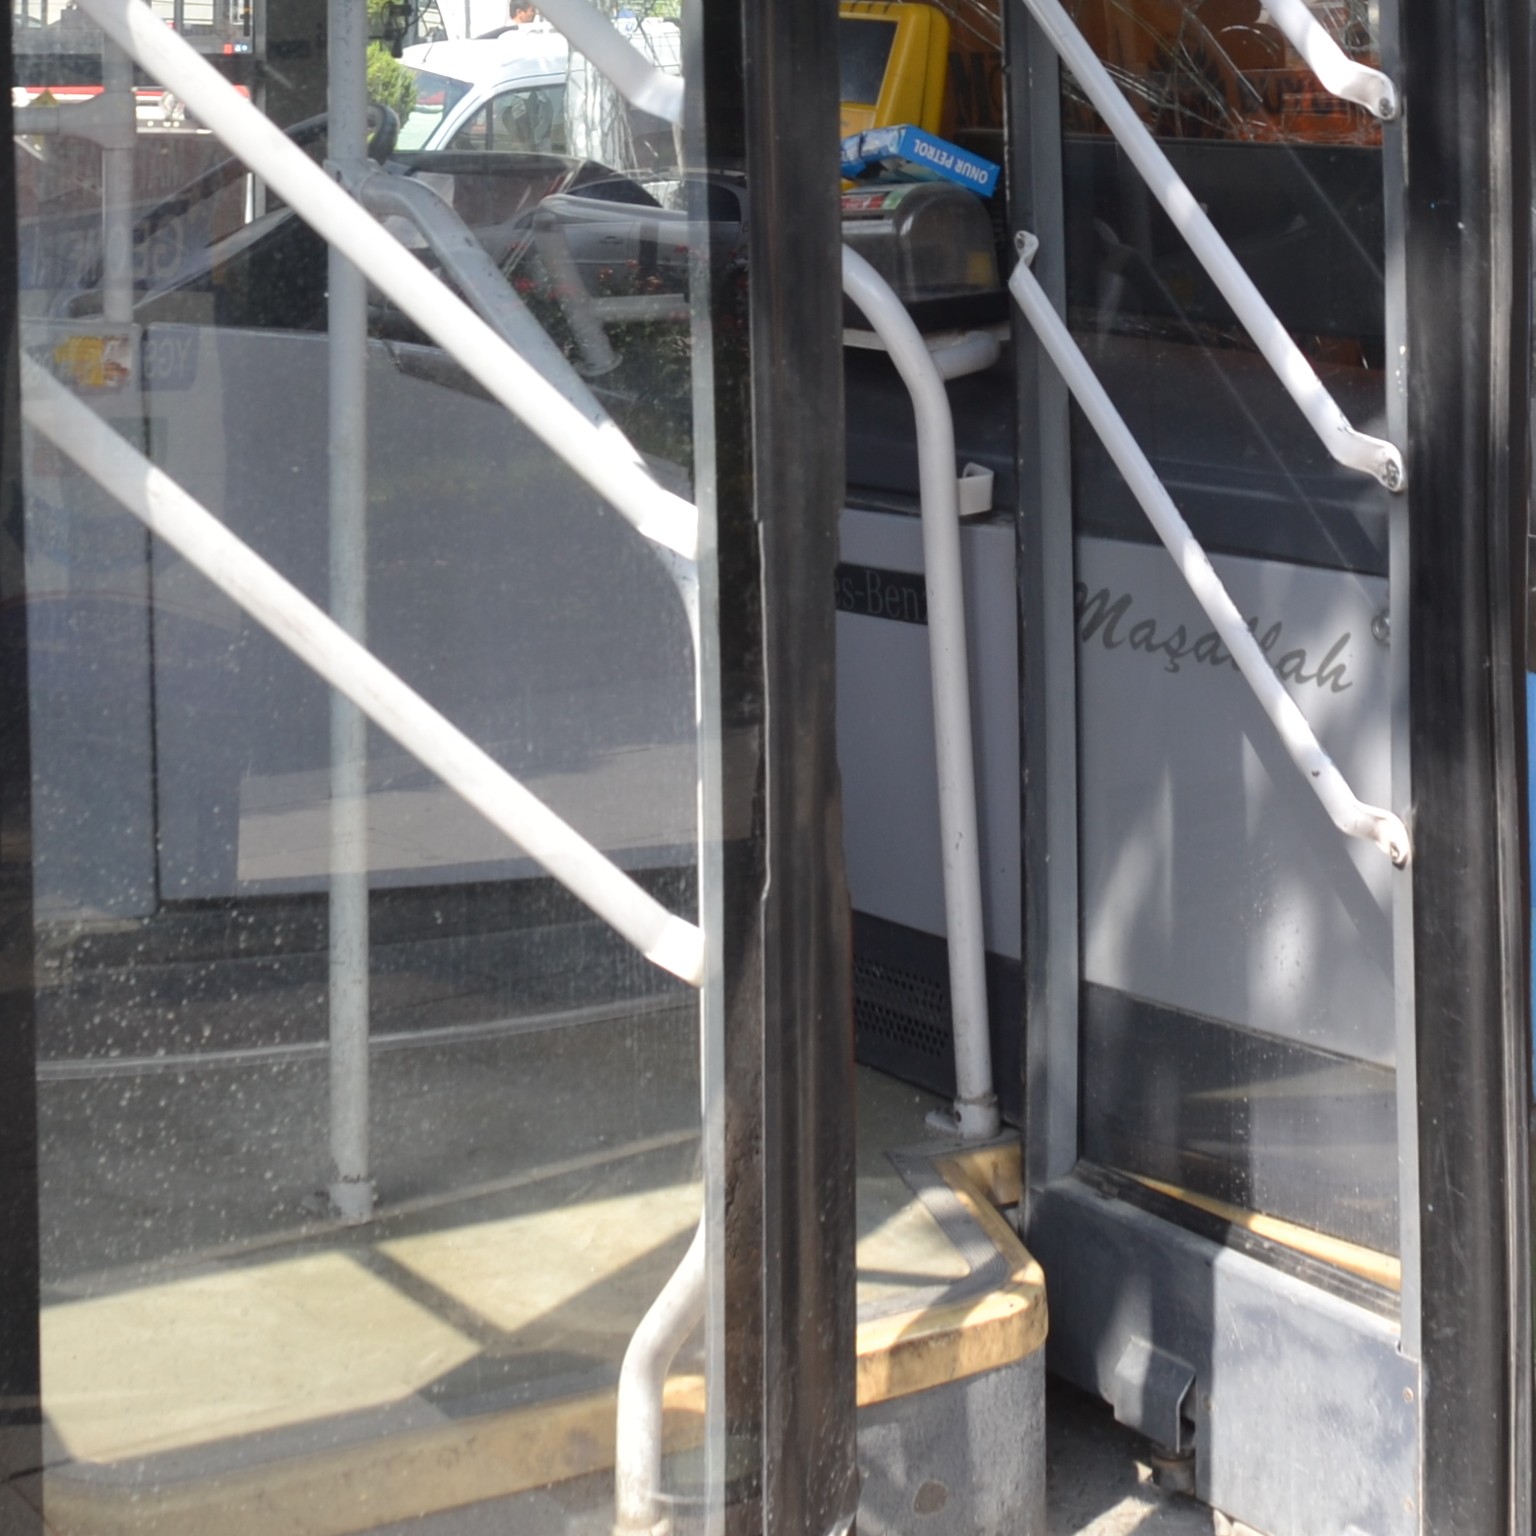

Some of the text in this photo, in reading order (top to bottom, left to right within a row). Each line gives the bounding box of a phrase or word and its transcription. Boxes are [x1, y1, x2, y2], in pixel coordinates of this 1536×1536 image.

[914, 138, 989, 185] ONUR PETROL
[834, 569, 927, 621] s-Ben
